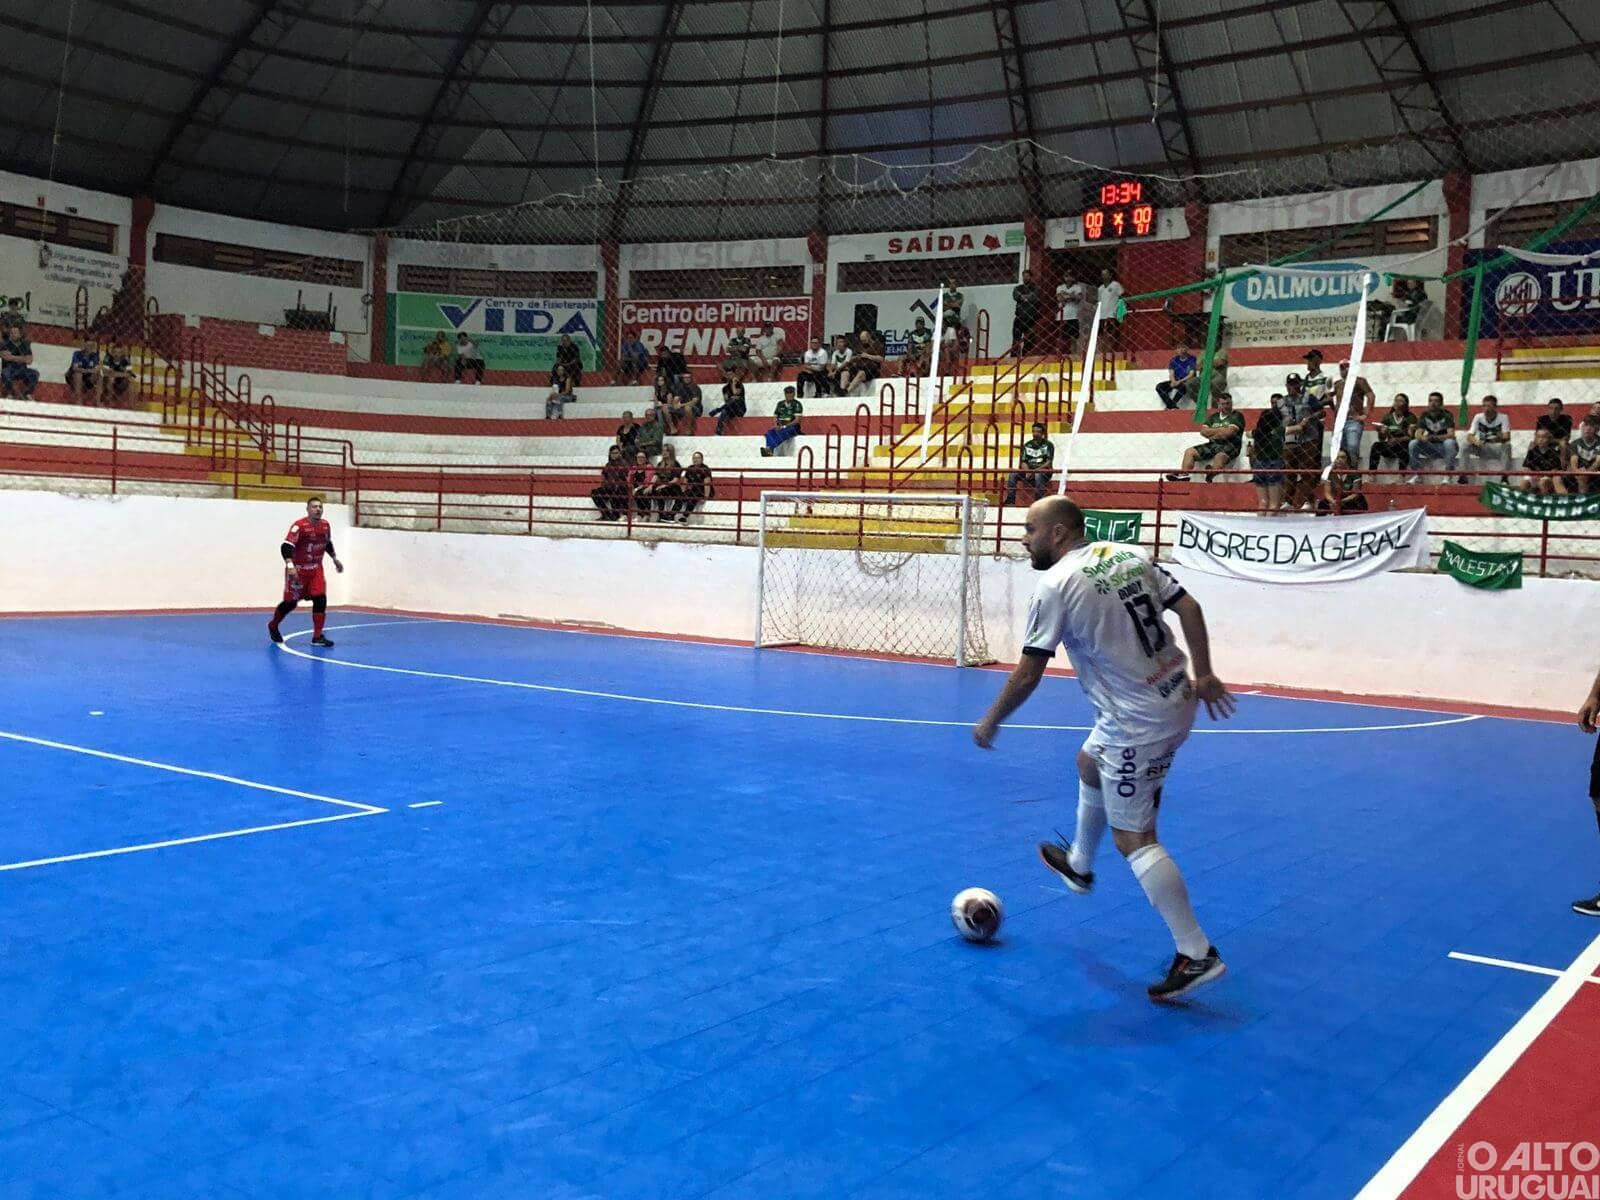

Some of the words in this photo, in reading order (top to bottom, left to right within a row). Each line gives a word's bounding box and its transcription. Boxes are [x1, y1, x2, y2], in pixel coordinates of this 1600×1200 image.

[1101, 182, 1141, 205] 13:34
[1085, 211, 1104, 229] 00
[1133, 206, 1152, 225] 00
[630, 240, 793, 270] PHYSICAL
[888, 231, 974, 254] SAÍDA
[1247, 274, 1367, 302] DALMOLIN
[485, 299, 524, 308] Centro
[528, 300, 540, 309] de
[543, 300, 596, 311] Fisioterapia
[622, 303, 693, 325] Centro
[694, 303, 719, 324] de
[720, 302, 809, 323] Pinturas
[438, 298, 598, 350] VIDA
[1178, 518, 1270, 563] BUGRES
[1273, 533, 1317, 565] DA
[1320, 524, 1411, 563] GERAL
[1124, 593, 1167, 658] 13
[1117, 747, 1137, 798] Orbe
